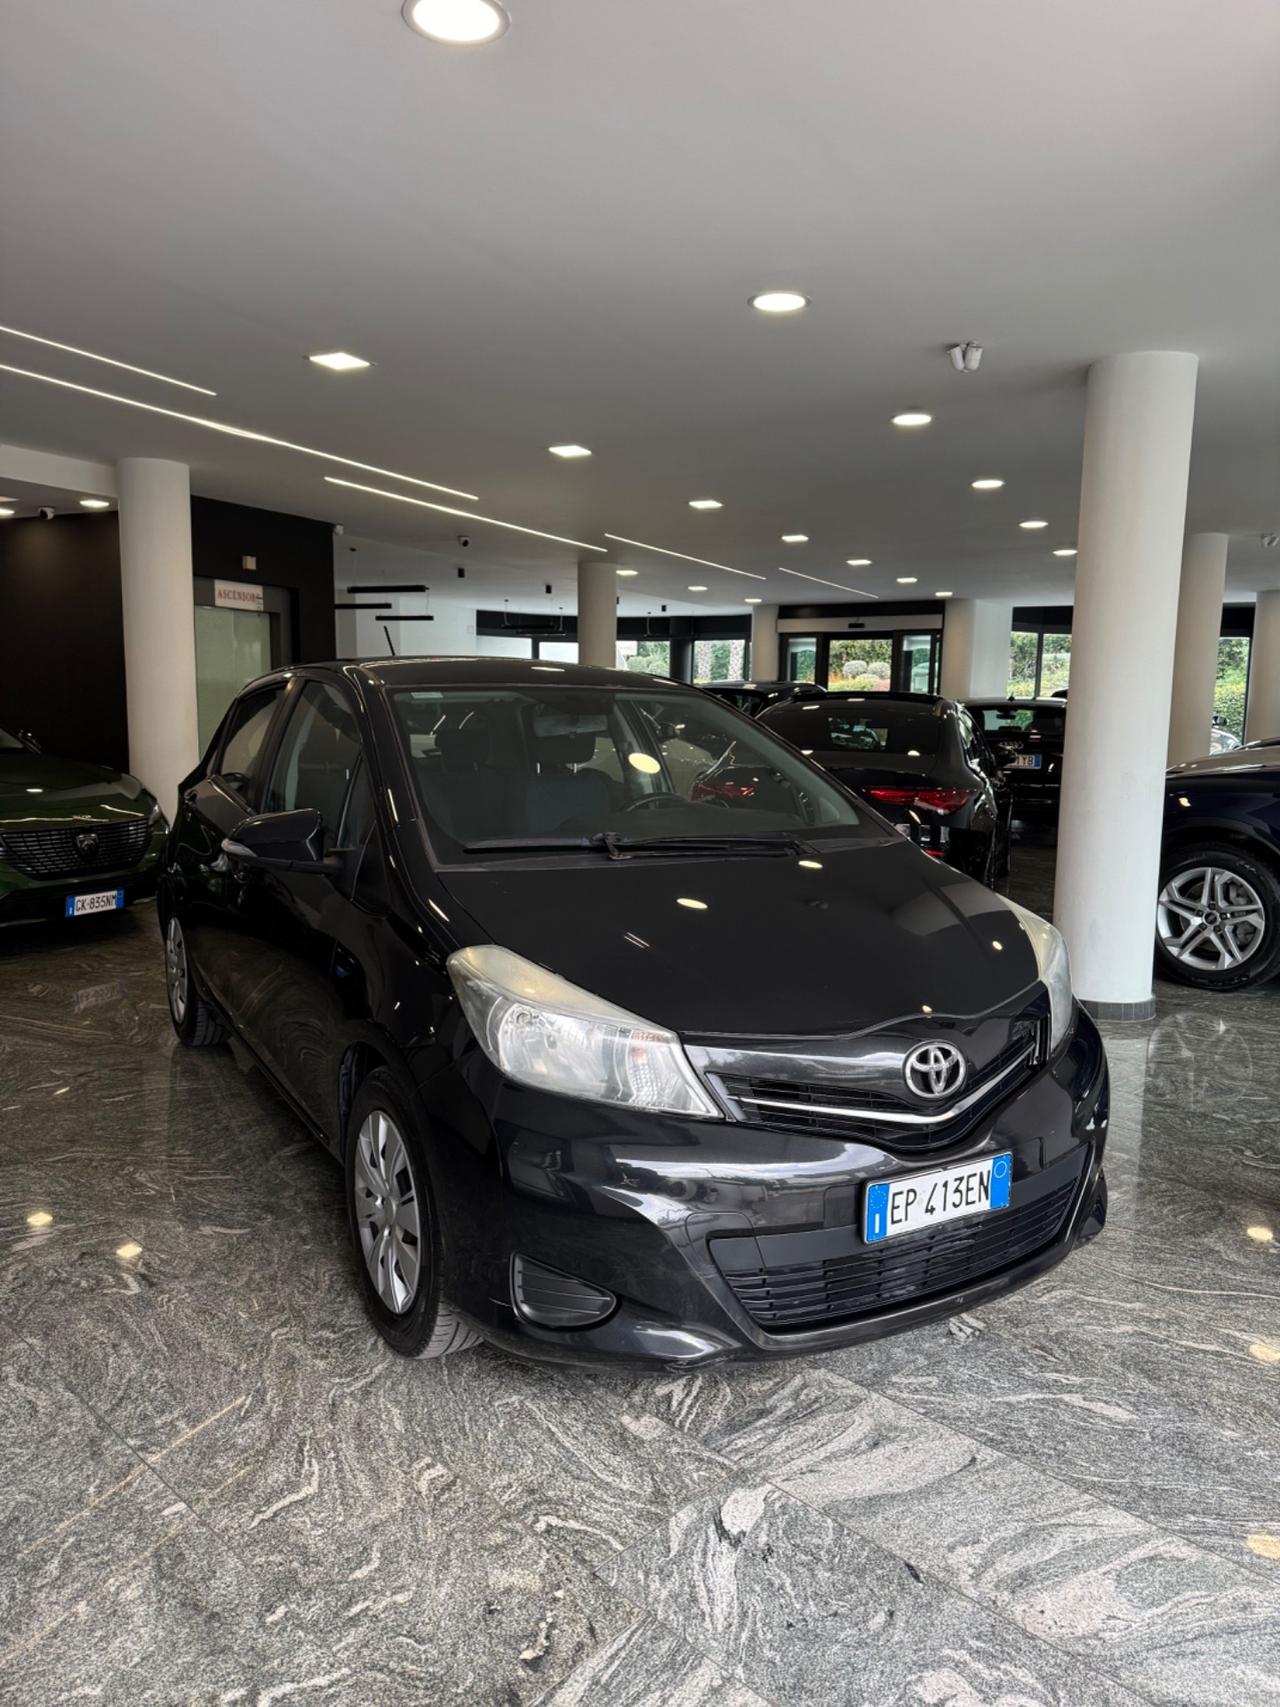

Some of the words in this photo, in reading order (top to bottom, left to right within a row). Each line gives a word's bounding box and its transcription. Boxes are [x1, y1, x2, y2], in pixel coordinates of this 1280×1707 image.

[217, 589, 262, 604] ASCENSOR
[890, 1188, 917, 1225] EP
[925, 1169, 991, 1215] 413EN
